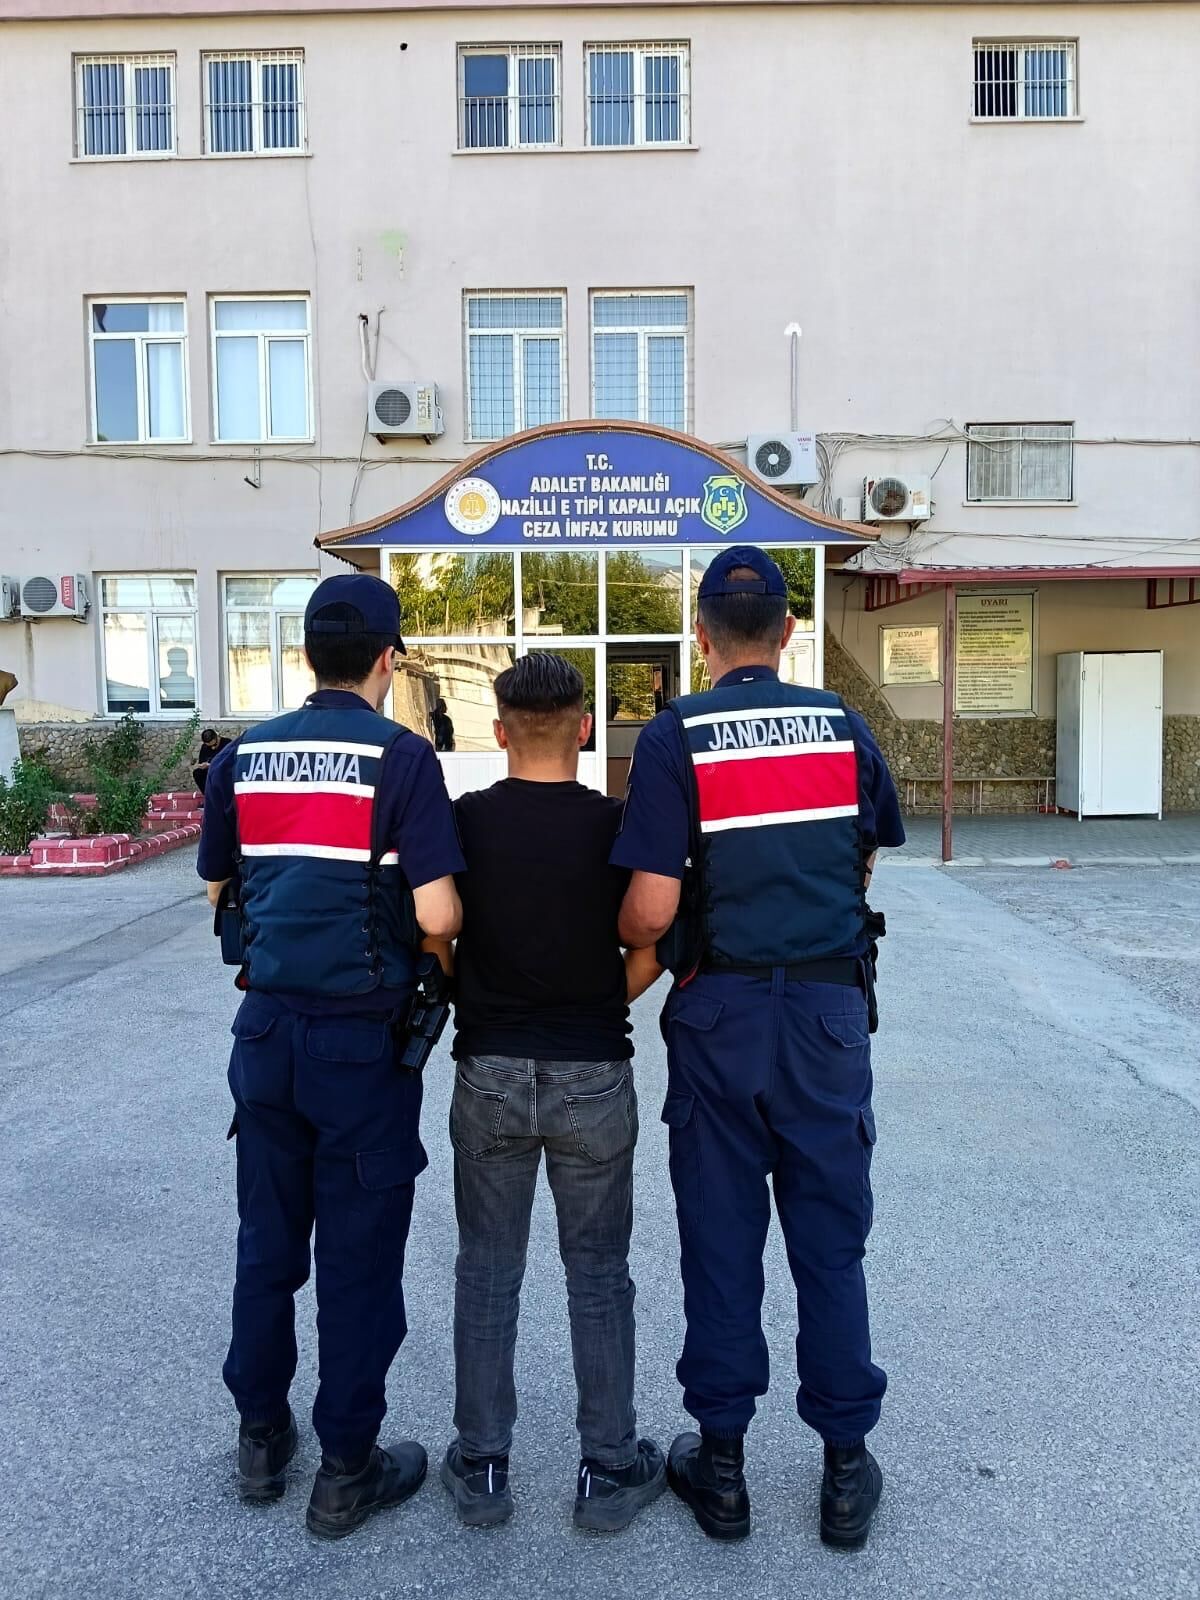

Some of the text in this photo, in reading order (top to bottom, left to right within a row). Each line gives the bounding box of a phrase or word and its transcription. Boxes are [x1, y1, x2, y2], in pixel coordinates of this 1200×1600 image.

[586, 454, 613, 470] T.C.
[530, 473, 670, 493] ADALET BAKANLIĞI
[501, 495, 700, 518] NAZİLLİ E TİPİ KAPALI AÇIK
[523, 518, 678, 537] CEZA İNFAZ KURUMU
[980, 598, 1008, 606] UYARI
[708, 716, 836, 750] JANDARMA
[242, 752, 361, 784] JANDARMA
